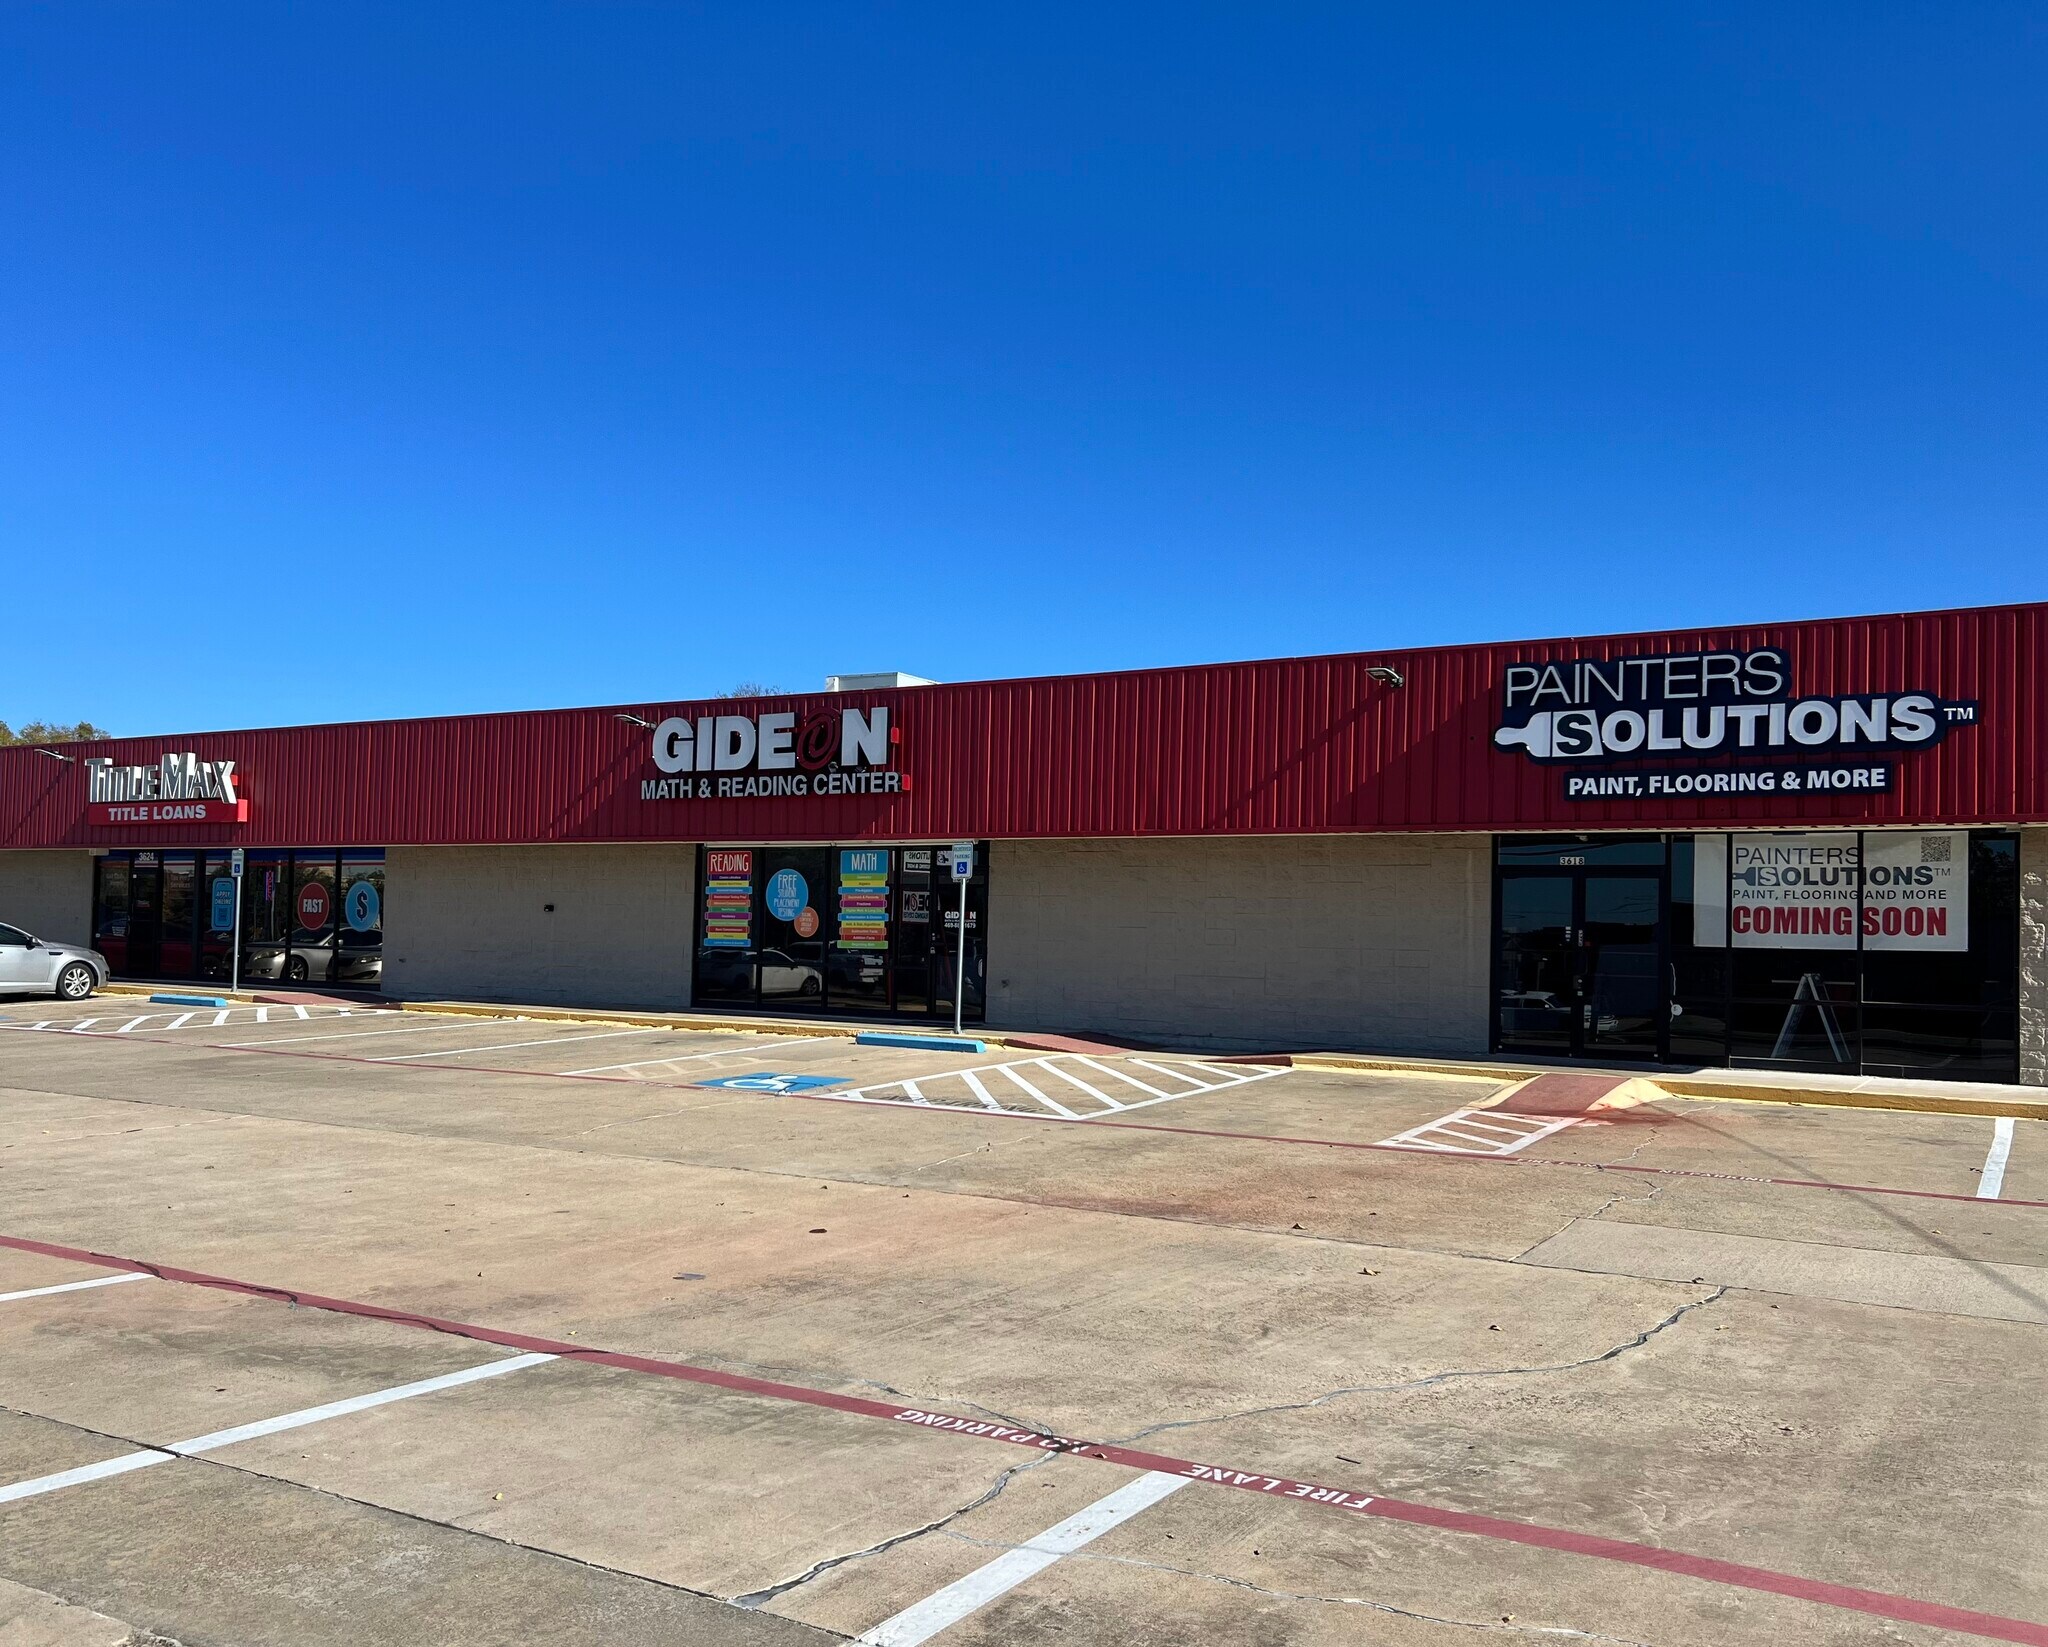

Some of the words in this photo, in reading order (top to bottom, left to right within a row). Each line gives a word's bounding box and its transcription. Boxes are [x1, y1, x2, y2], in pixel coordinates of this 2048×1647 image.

[1506, 651, 1783, 707] PAINTERS
[1553, 696, 1937, 757] SOLUTIONS
[652, 706, 888, 774] GIDEON
[641, 777, 692, 800] MATH
[699, 777, 711, 798] &
[718, 774, 807, 798] READING
[813, 771, 899, 795] CENTER
[1569, 775, 1643, 797] PAINT,
[1649, 770, 1775, 794] FLOORING
[1781, 770, 1801, 790] &
[1807, 767, 1886, 789] MORE
[108, 807, 148, 821] TITLE
[153, 805, 206, 820] LOANS
[138, 852, 154, 861] 3624
[710, 854, 749, 872] READING
[851, 853, 878, 871] MATH
[1560, 857, 1585, 865] 3618
[1735, 847, 1858, 865] PAINTERS
[778, 874, 797, 889] FREE
[1758, 866, 1933, 886] SOLUTIONS
[1733, 890, 1779, 901] PAINT,
[1783, 890, 1858, 900] FLOORING
[1865, 890, 1897, 900] AND
[1902, 890, 1947, 900] MORE
[302, 899, 324, 913] FAST
[1732, 906, 1853, 935] COMING
[1863, 907, 1947, 936] SOON
[894, 1409, 1037, 1443] PARKING
[1180, 1464, 1282, 1491] LANE
[1284, 1483, 1375, 1509] FIRE
